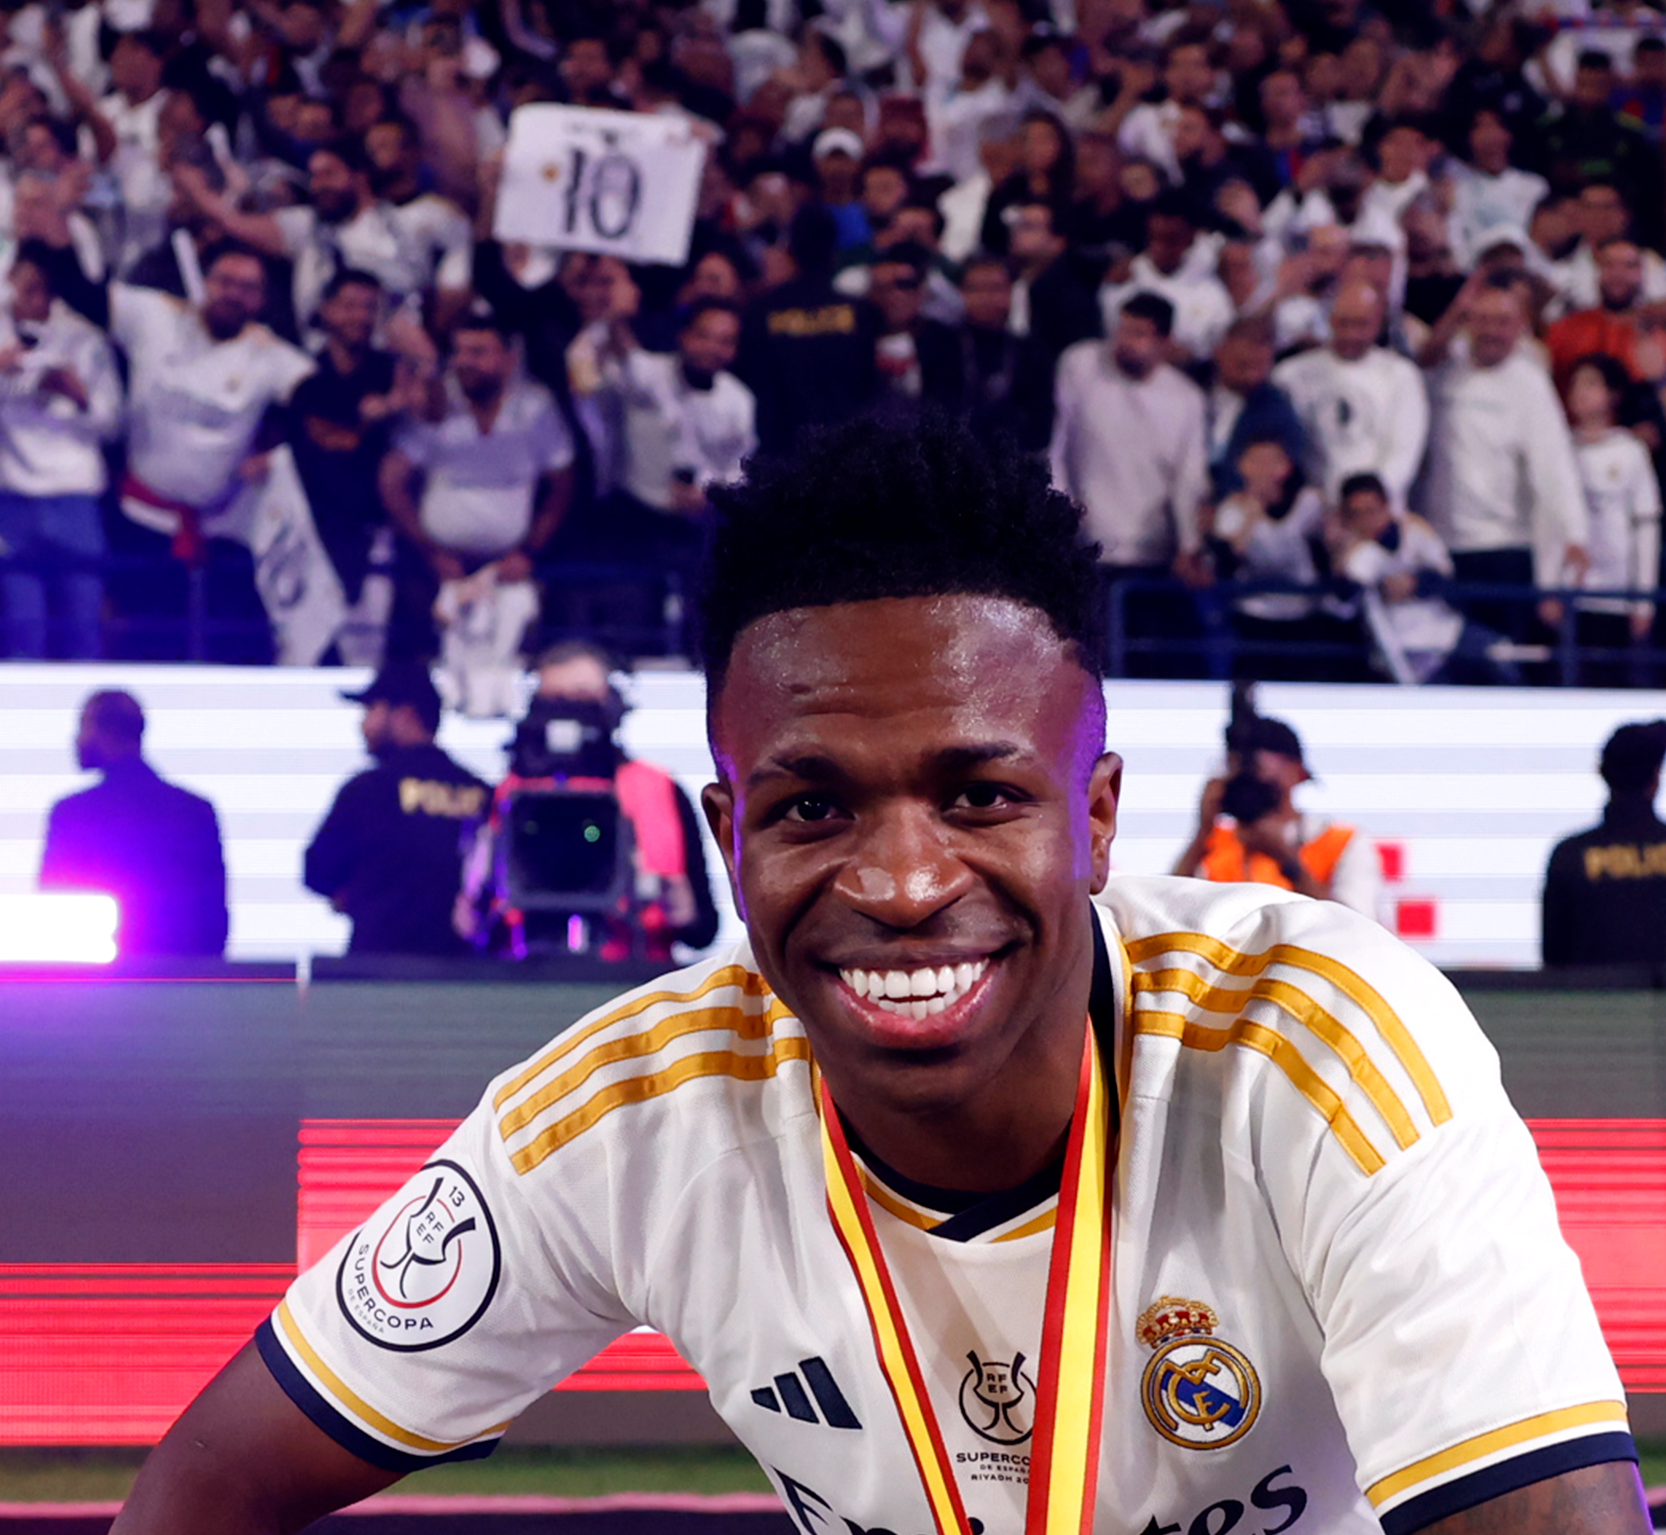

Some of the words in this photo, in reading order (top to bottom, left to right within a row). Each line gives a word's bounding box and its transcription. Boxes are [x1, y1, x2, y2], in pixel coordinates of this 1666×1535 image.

[448, 1186, 465, 1207] 13
[354, 1243, 434, 1331] SUPERCOPA
[956, 1452, 1031, 1466] SUPERCO
[996, 1464, 1030, 1474] ESPAÑ
[971, 1474, 1013, 1483] RIYADH
